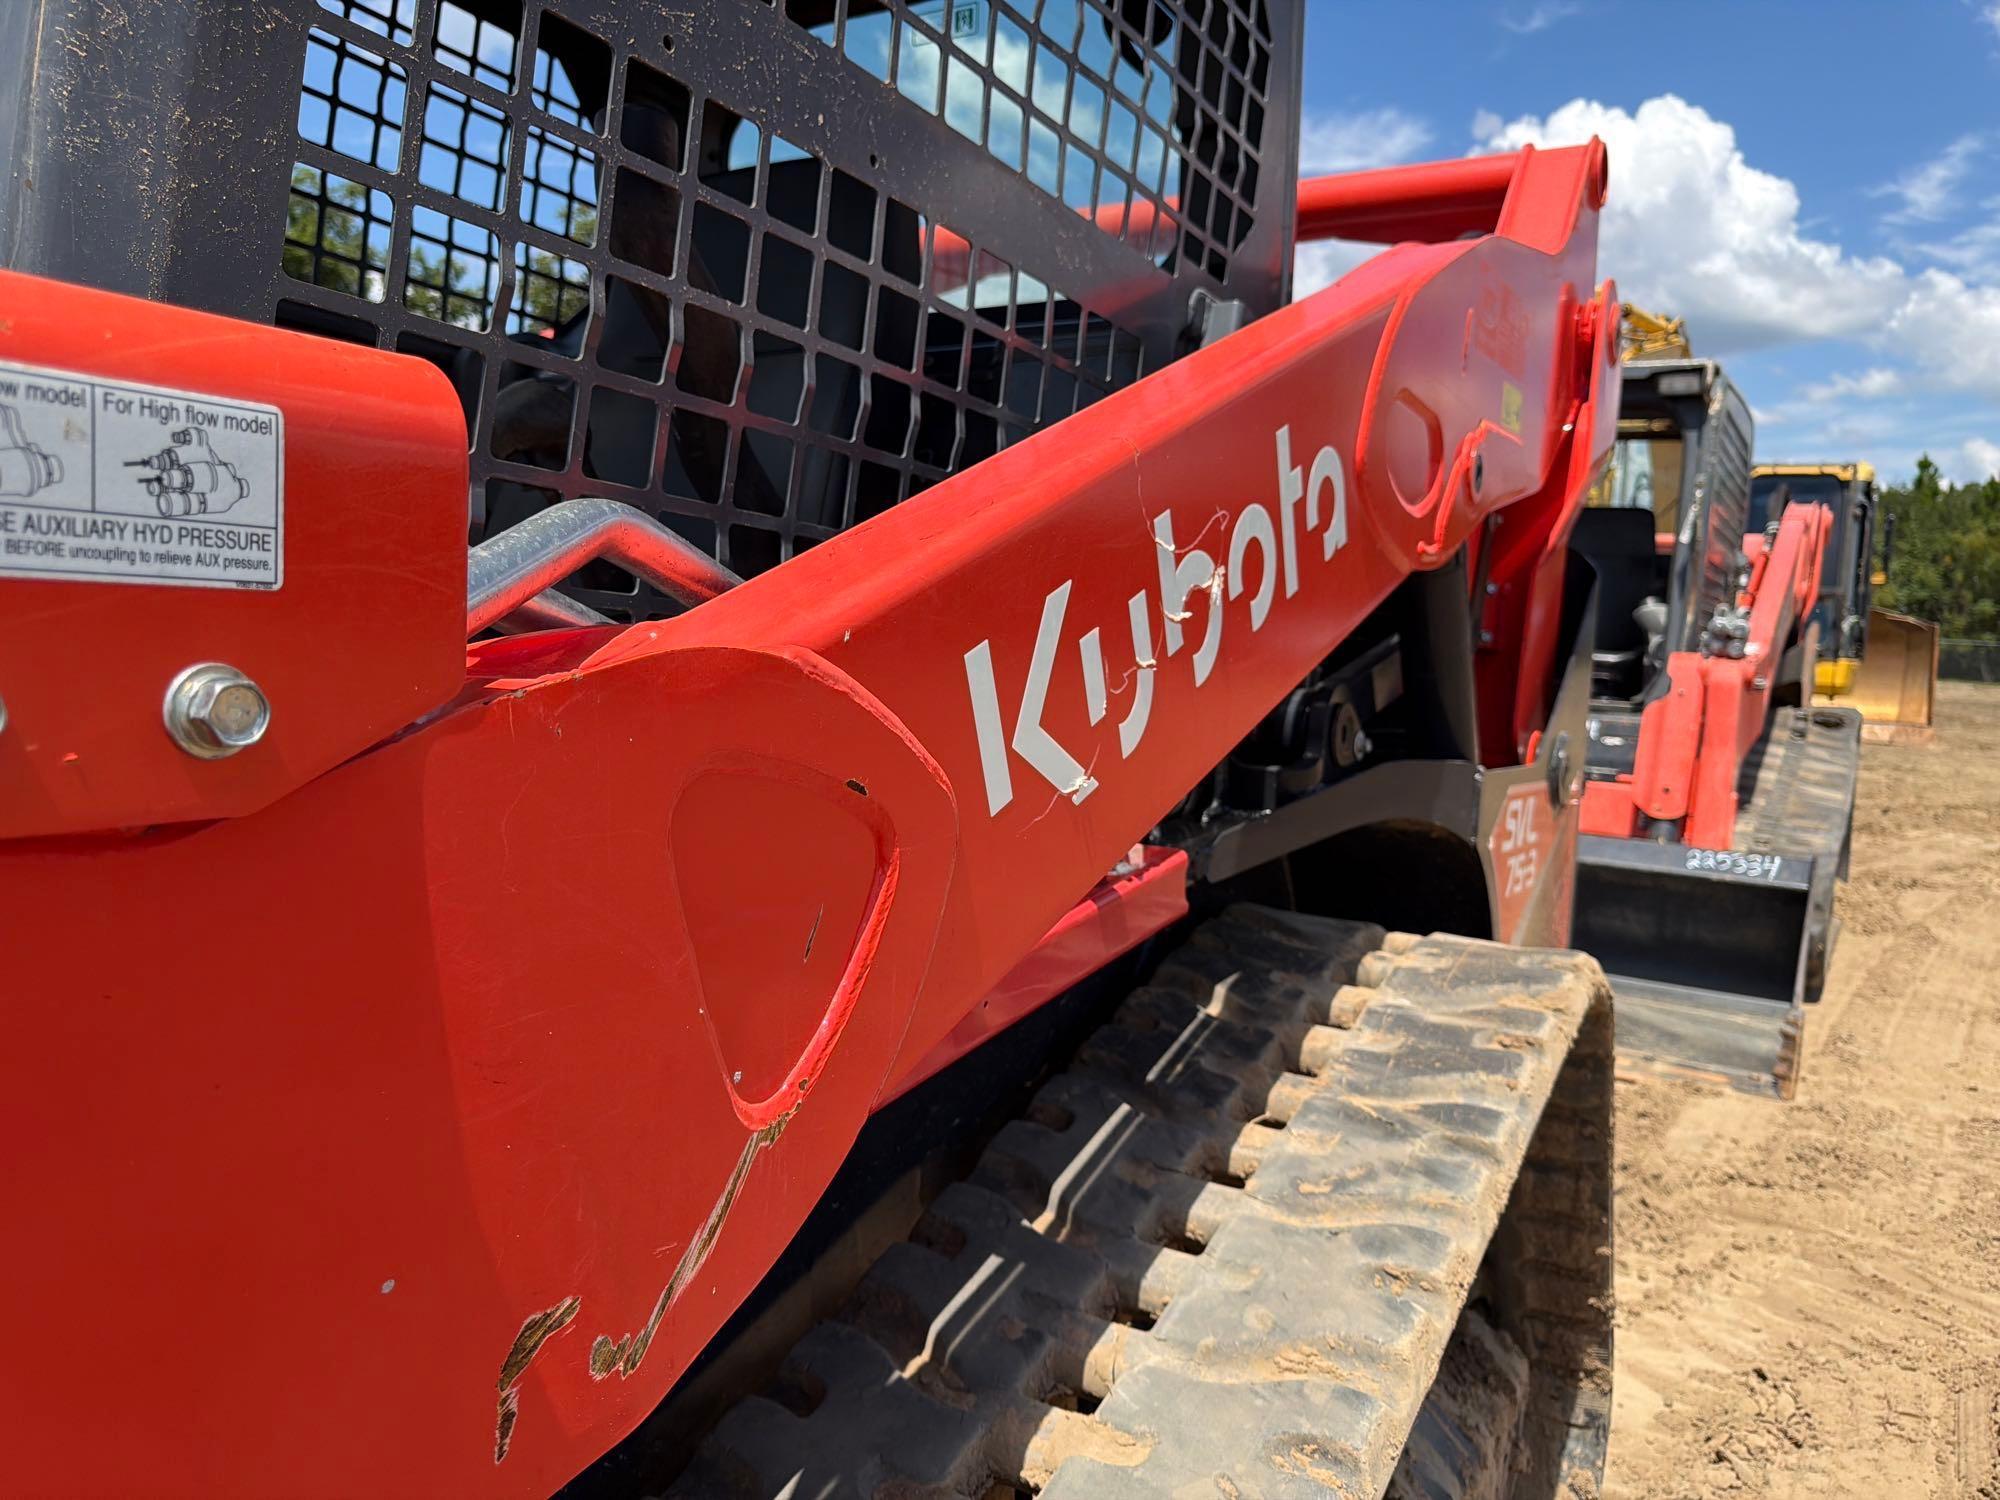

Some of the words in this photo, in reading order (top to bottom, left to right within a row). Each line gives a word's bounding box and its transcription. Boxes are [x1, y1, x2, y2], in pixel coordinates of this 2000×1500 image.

[26, 384, 87, 408] model
[103, 392, 133, 415] For
[139, 397, 180, 425] High
[185, 405, 219, 428] flow
[224, 414, 273, 435] model
[23, 513, 128, 541] AUXILIARY
[133, 522, 173, 545] HYD
[178, 526, 272, 552] PRESSURE
[6, 538, 66, 558] BEFORE
[69, 546, 136, 566] uncoupling
[140, 549, 152, 563] to
[154, 550, 192, 566] relieve
[195, 552, 221, 567] AUX
[223, 556, 272, 571] pressure.
[964, 424, 1348, 818] Kubota
[1502, 796, 1538, 853] SVL
[1505, 848, 1538, 897] 75-3
